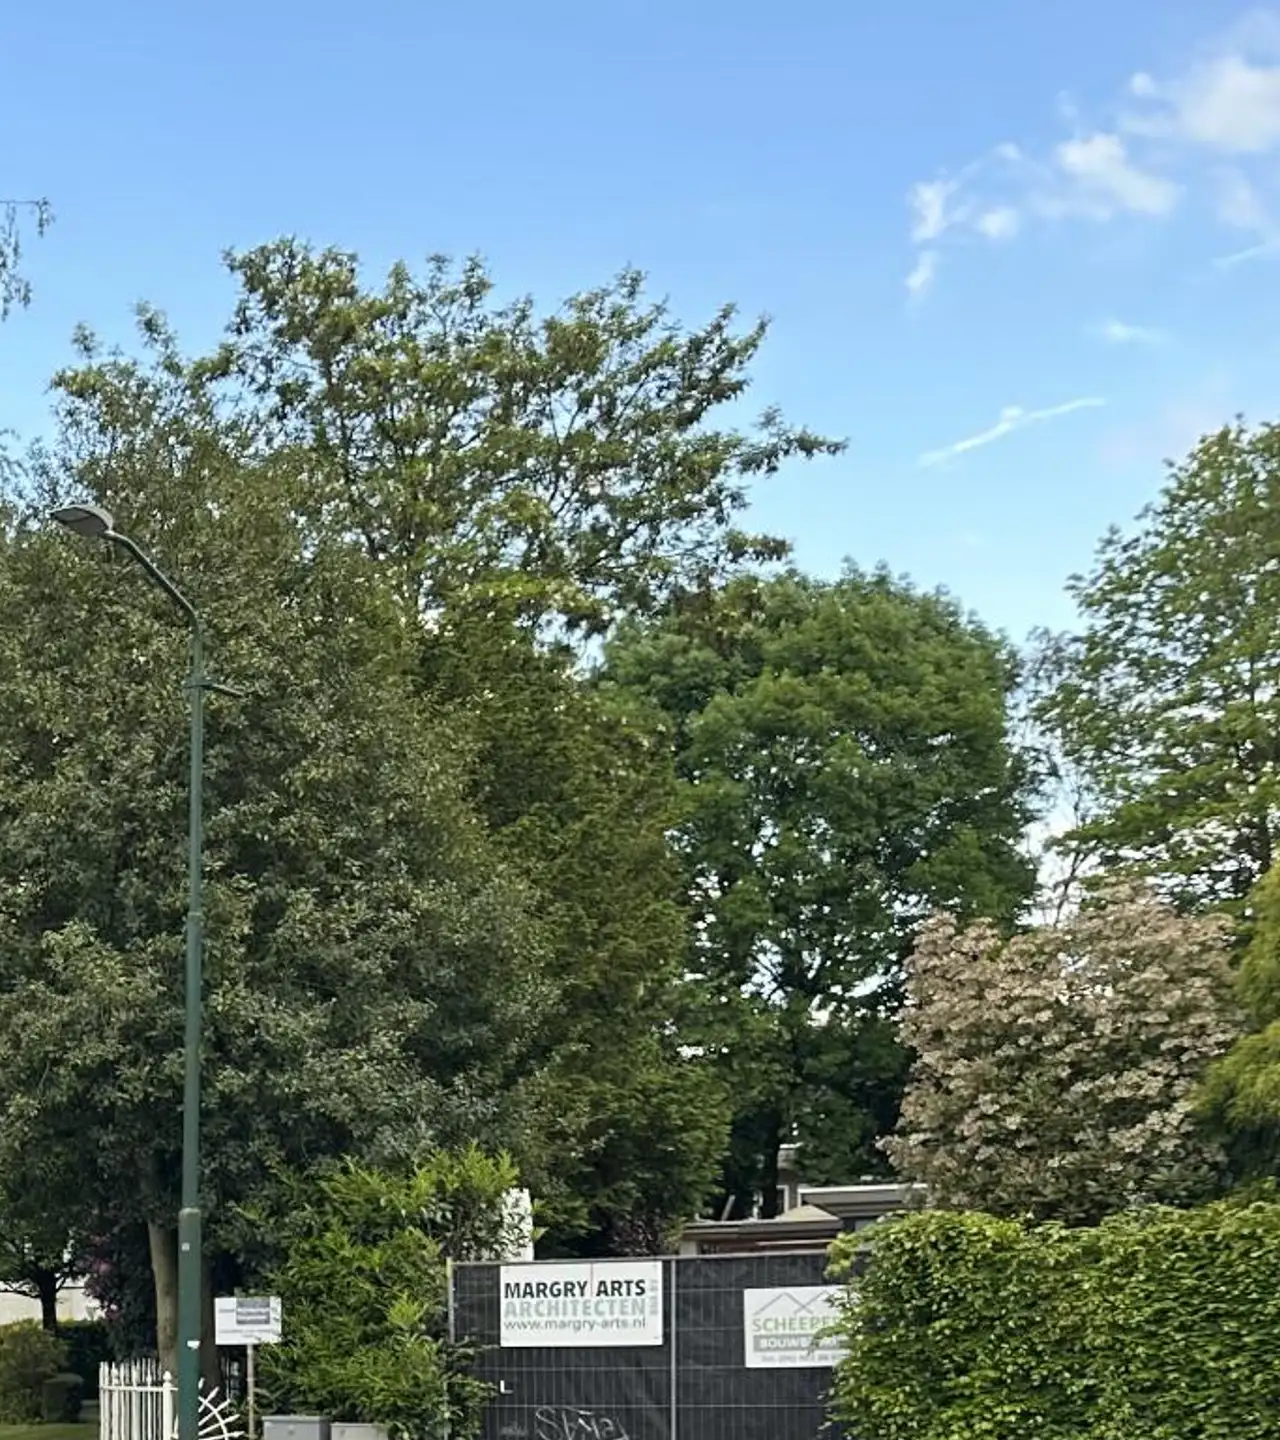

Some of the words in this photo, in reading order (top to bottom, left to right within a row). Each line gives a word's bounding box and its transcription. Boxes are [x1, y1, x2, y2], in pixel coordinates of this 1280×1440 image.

[504, 1281, 587, 1299] MARGRY
[595, 1279, 646, 1297] ARTS
[504, 1299, 646, 1318] ARCHITECTEN
[504, 1316, 646, 1335] www.margry-arts.nl
